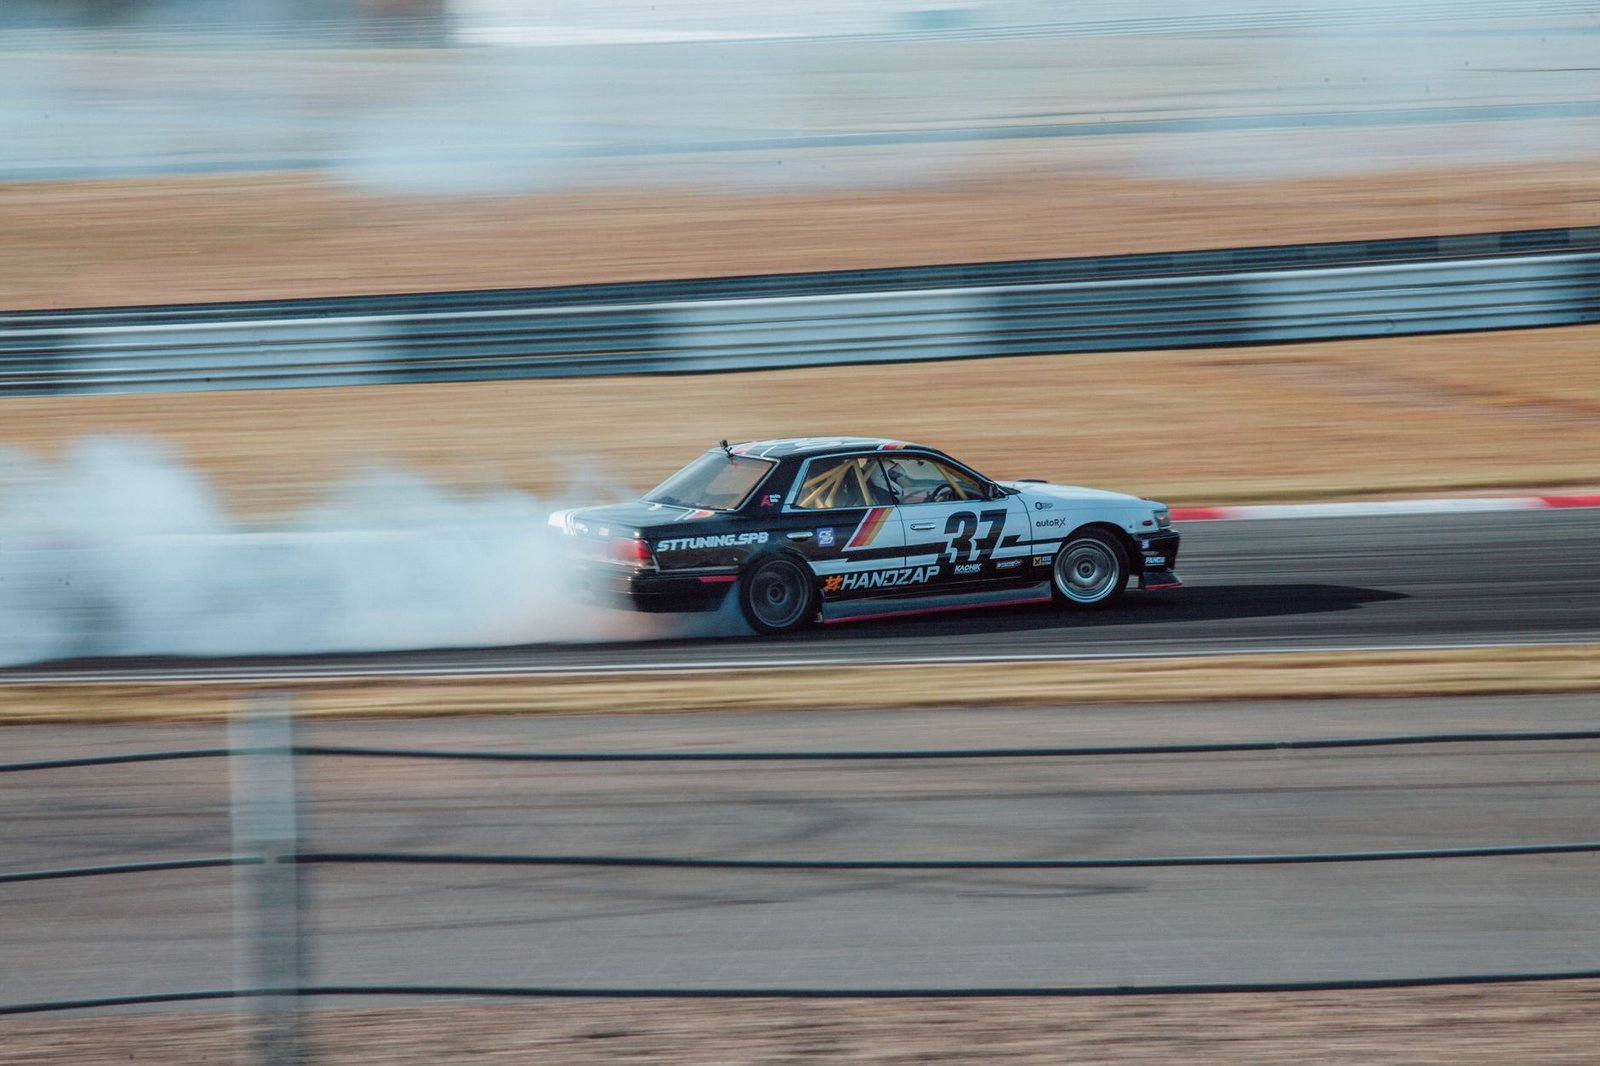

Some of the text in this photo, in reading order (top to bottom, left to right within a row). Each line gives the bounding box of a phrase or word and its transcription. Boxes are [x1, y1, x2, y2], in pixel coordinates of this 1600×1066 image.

[1035, 517, 1066, 528] autoRX
[656, 532, 769, 552] STTUNING.SPB
[943, 508, 1008, 562] 37
[823, 565, 940, 592] #HANDZAP
